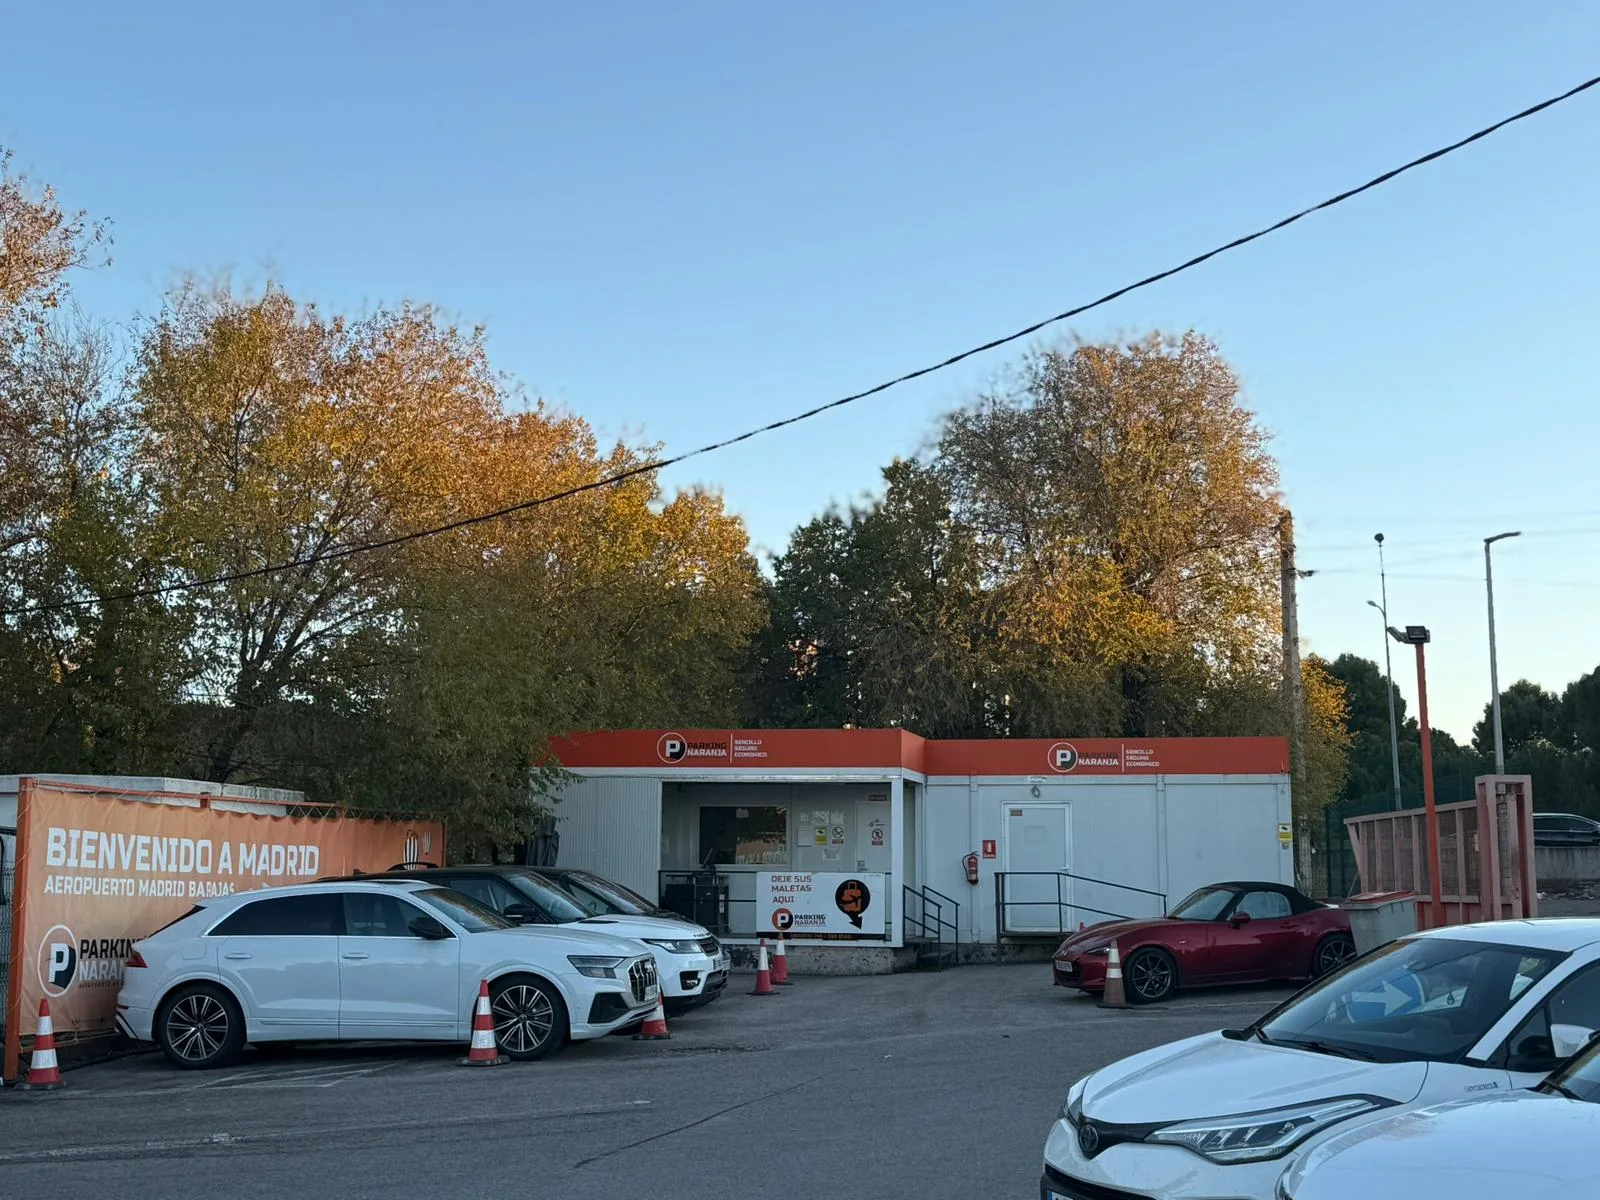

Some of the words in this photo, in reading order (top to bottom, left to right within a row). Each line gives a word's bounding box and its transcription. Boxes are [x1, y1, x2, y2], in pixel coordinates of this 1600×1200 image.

[687, 749, 727, 757] NARANJA
[1079, 758, 1119, 766] NARANJA
[46, 827, 212, 875] BIENVENIDO
[217, 841, 233, 875] A
[238, 843, 320, 877] MADRID
[771, 875, 792, 883] DEJE
[794, 875, 812, 883] SUS
[44, 874, 135, 897] AEROPUERTO
[138, 879, 186, 897] MADRID
[771, 885, 812, 893] MALETAS
[772, 895, 794, 904] AQUI
[79, 938, 145, 959] PARKIN
